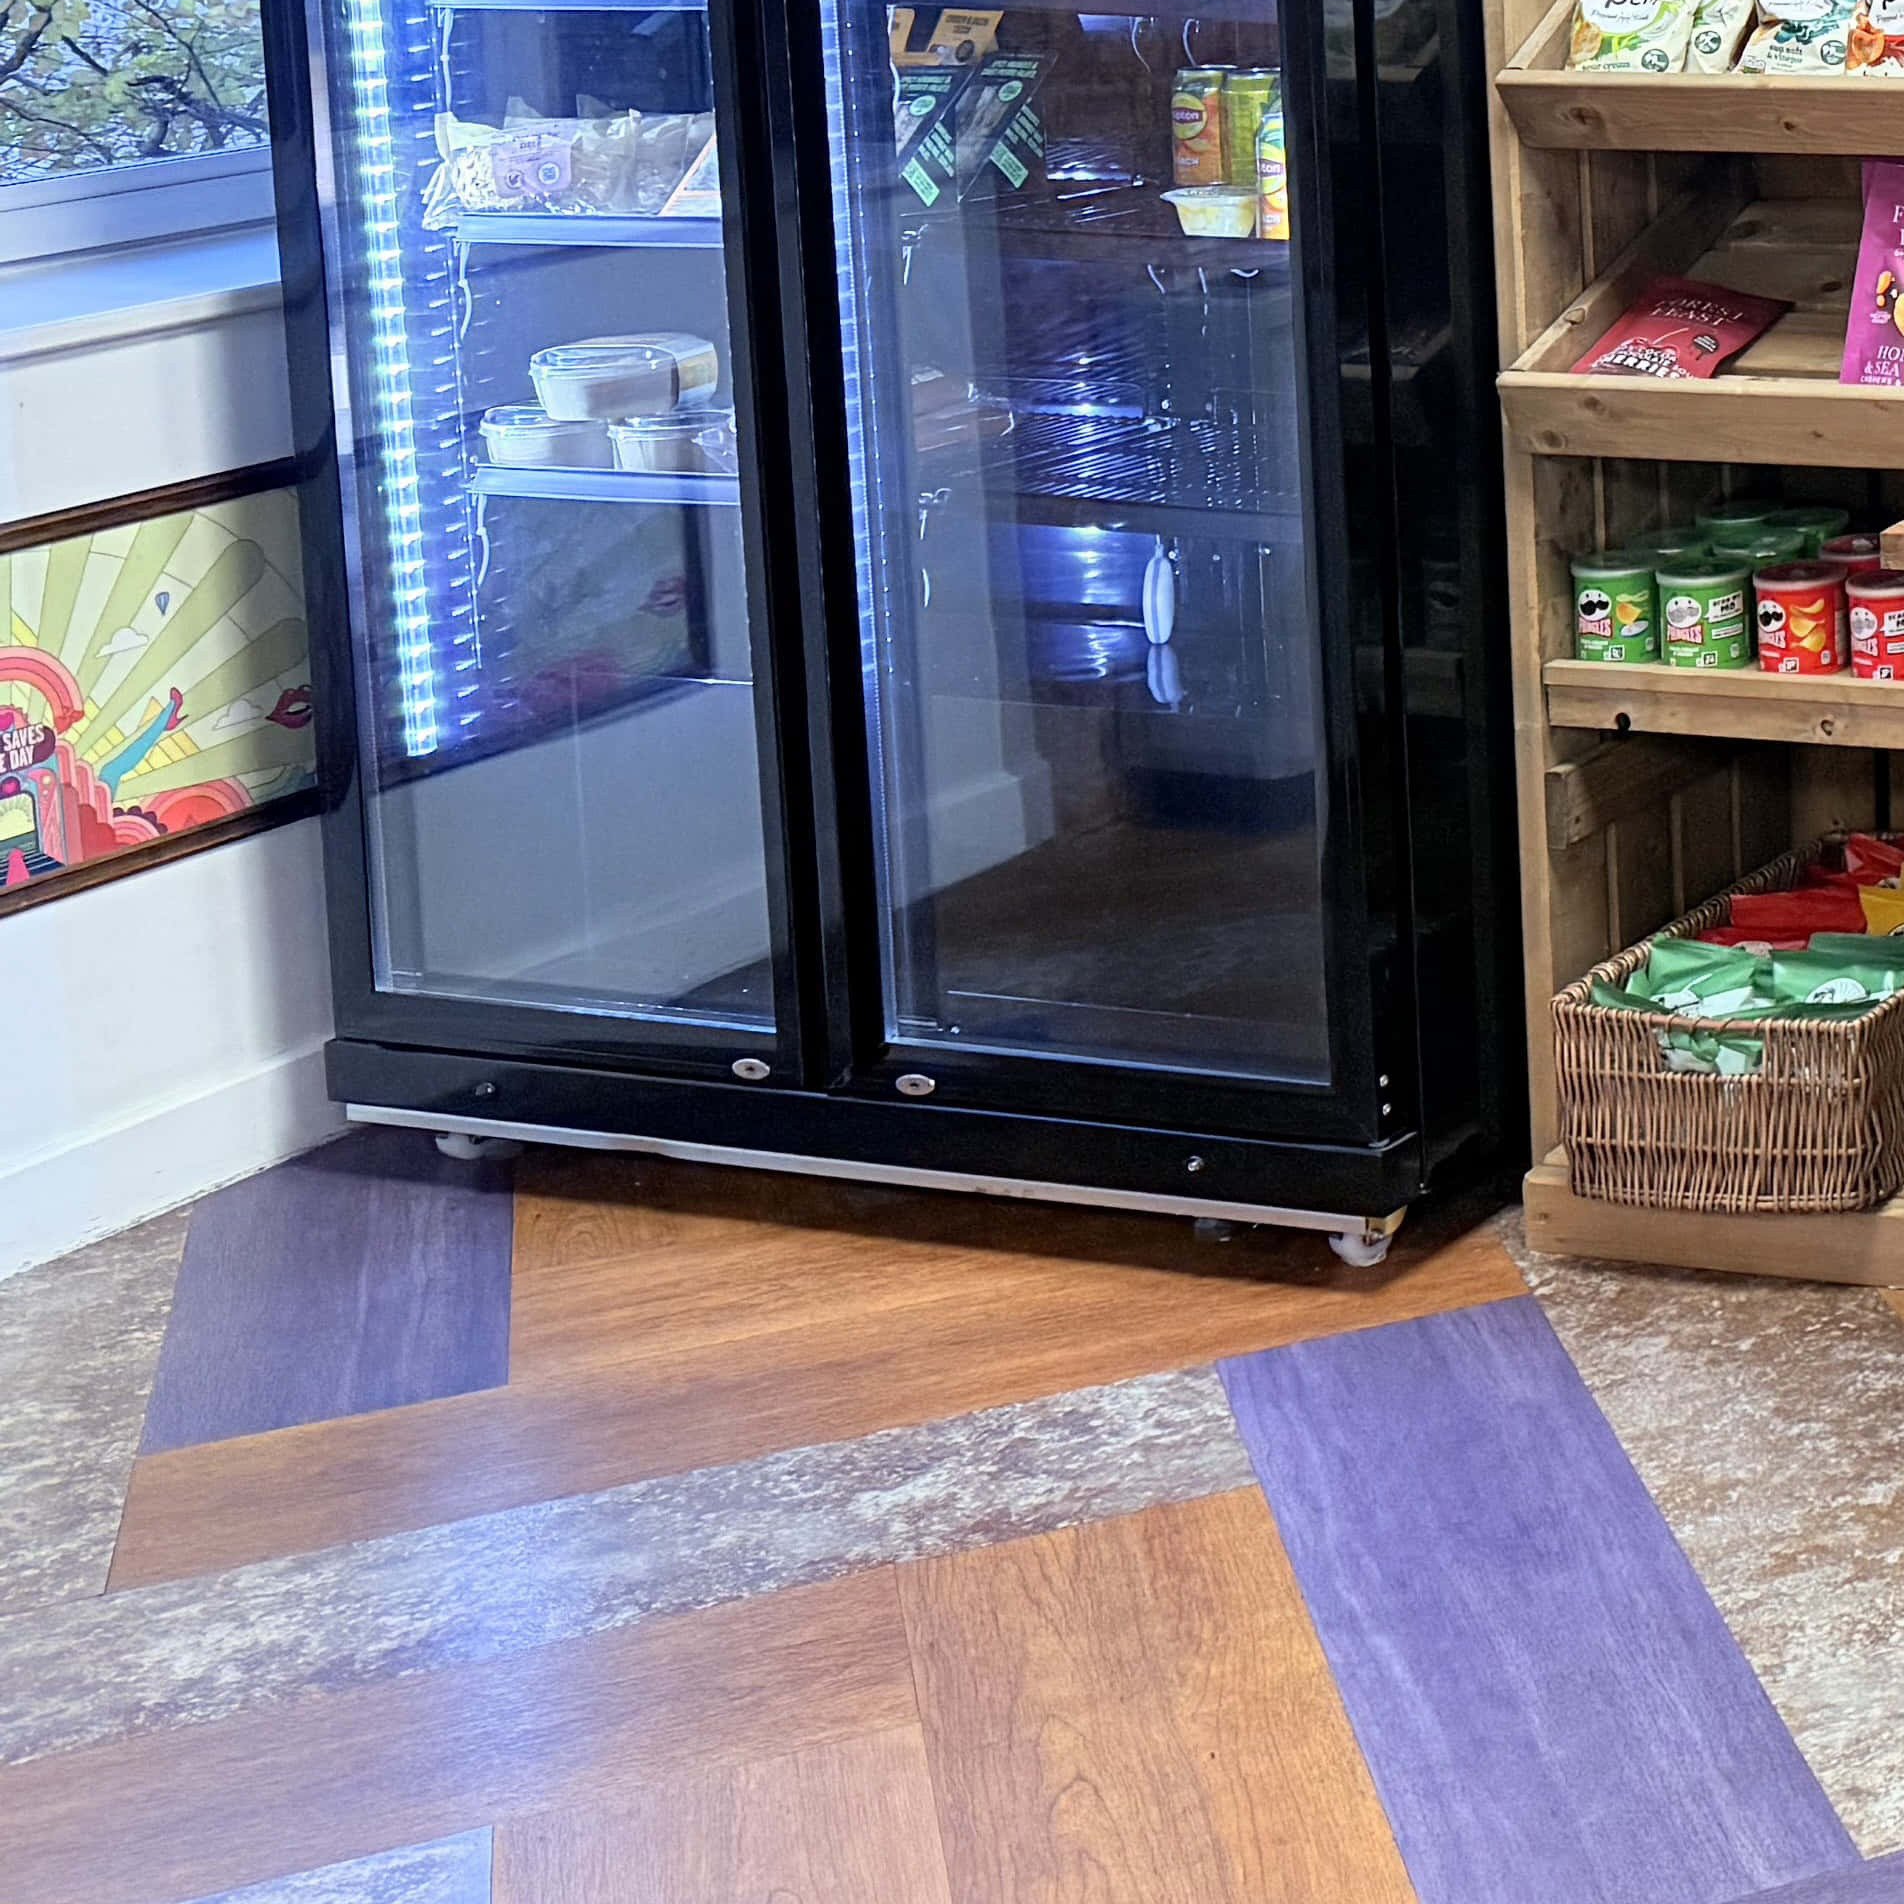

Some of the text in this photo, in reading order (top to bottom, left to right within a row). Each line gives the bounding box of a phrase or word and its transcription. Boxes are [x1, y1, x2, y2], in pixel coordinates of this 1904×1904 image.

[1875, 361, 1900, 378] SEA
[2, 724, 45, 752] SAVES
[9, 746, 35, 767] DAY
